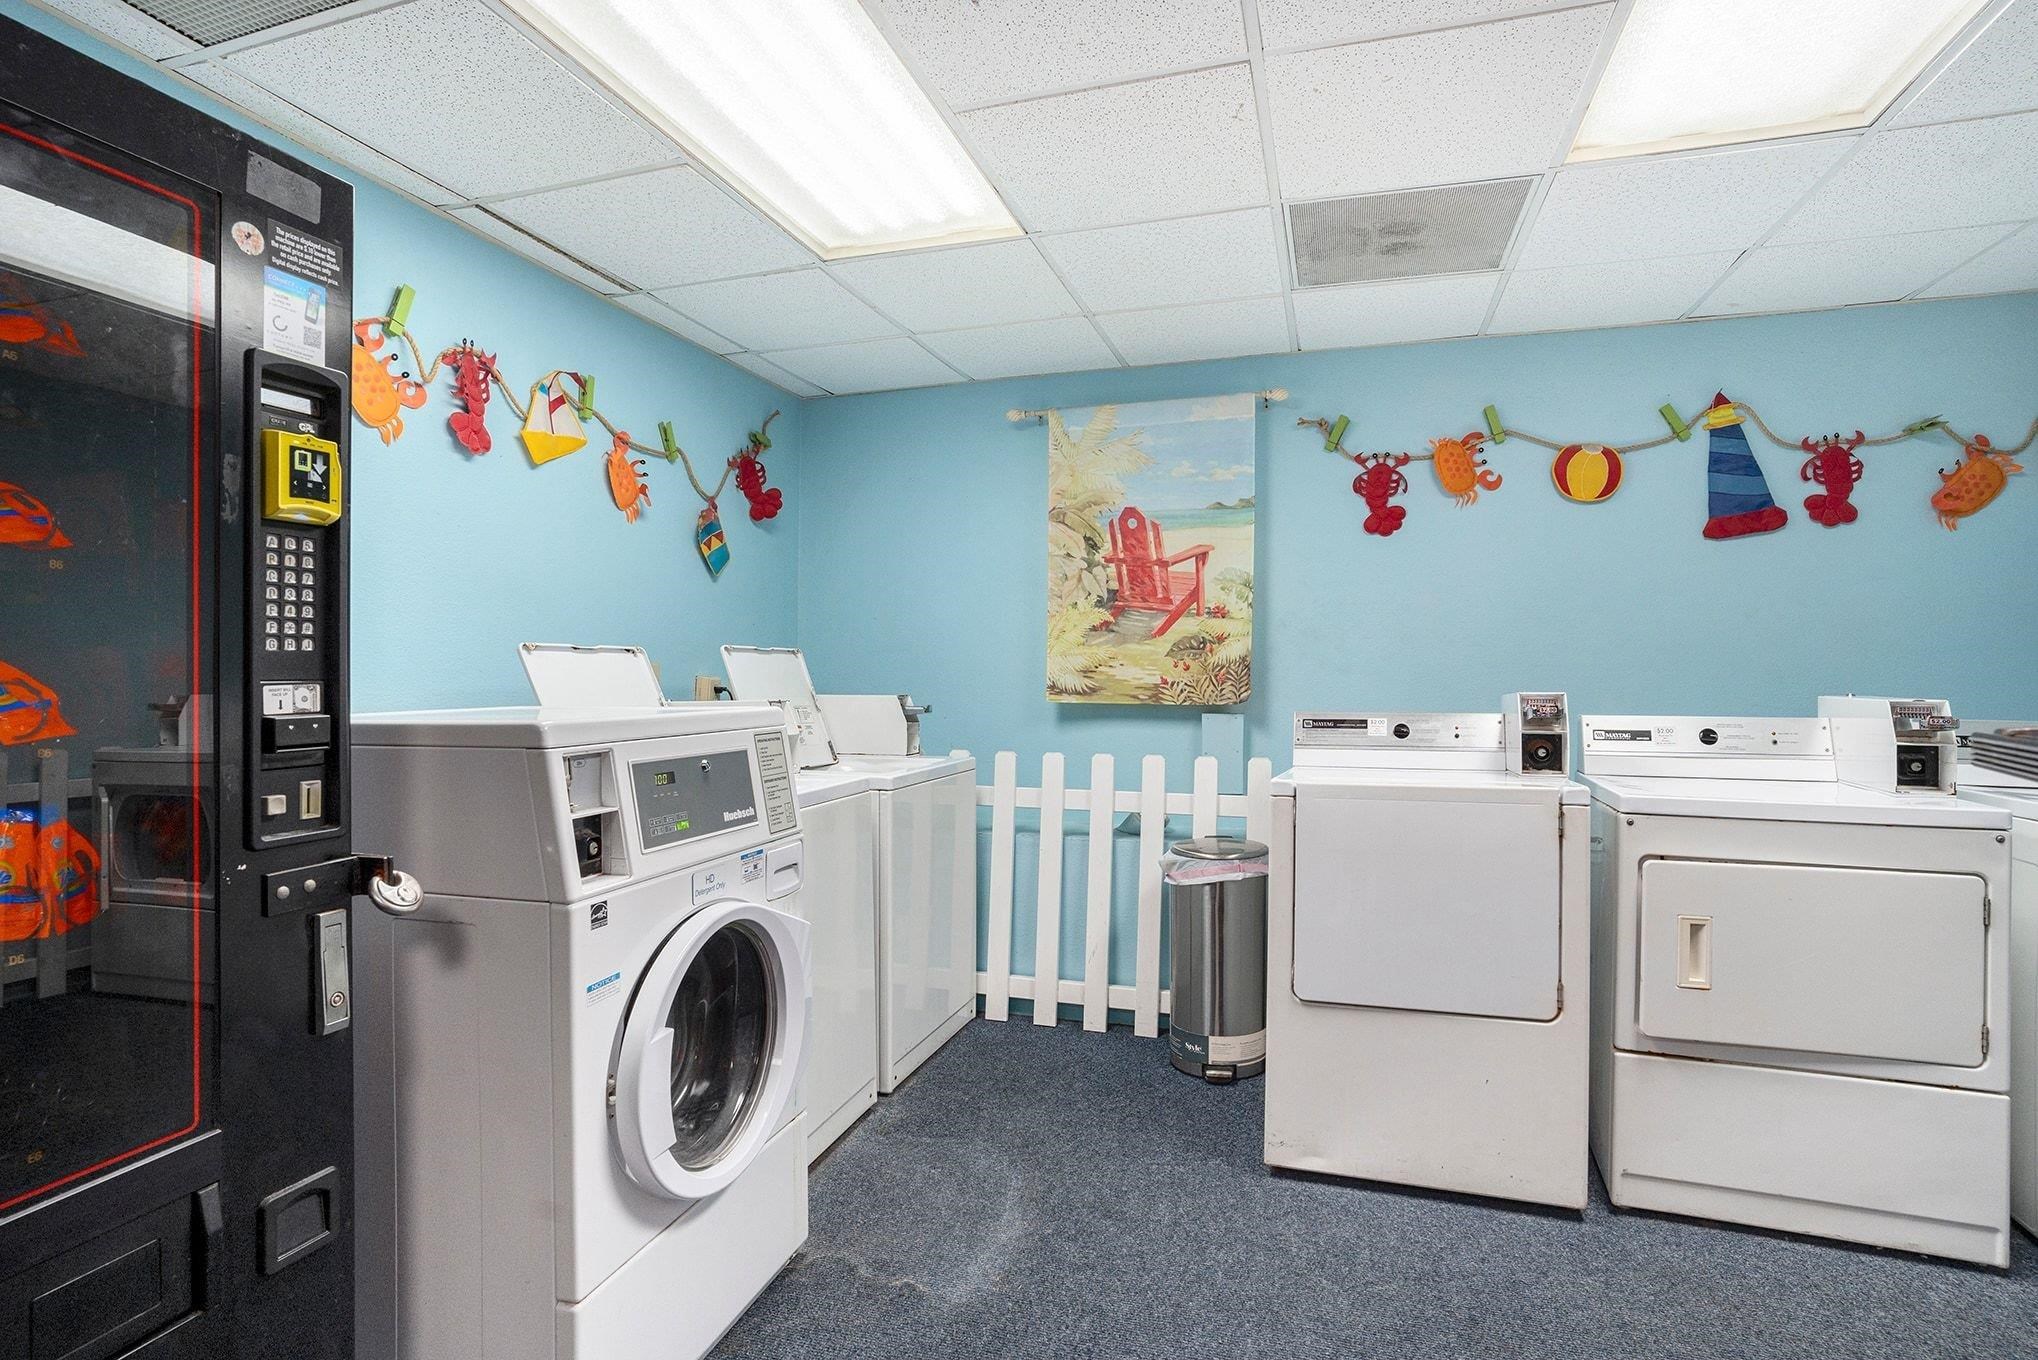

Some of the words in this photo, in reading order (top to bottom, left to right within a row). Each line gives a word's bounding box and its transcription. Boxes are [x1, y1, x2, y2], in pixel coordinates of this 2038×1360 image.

[275, 235, 295, 247] machine
[314, 249, 326, 259] lower
[326, 255, 336, 263] than
[276, 227, 284, 235] The
[285, 232, 300, 241] prices
[300, 237, 321, 250] displayed
[327, 248, 336, 256] this
[271, 240, 279, 248] the
[279, 244, 292, 253] retail
[292, 249, 304, 258] price
[321, 261, 340, 272] available
[271, 256, 286, 266] Digital
[286, 262, 301, 273] display
[301, 268, 318, 278] reflects
[318, 274, 328, 282] cash
[287, 254, 299, 263] cash
[299, 259, 322, 272] purchases
[723, 806, 756, 822] Huebsch
[695, 885, 716, 897] Detergent
[716, 881, 726, 891] Only
